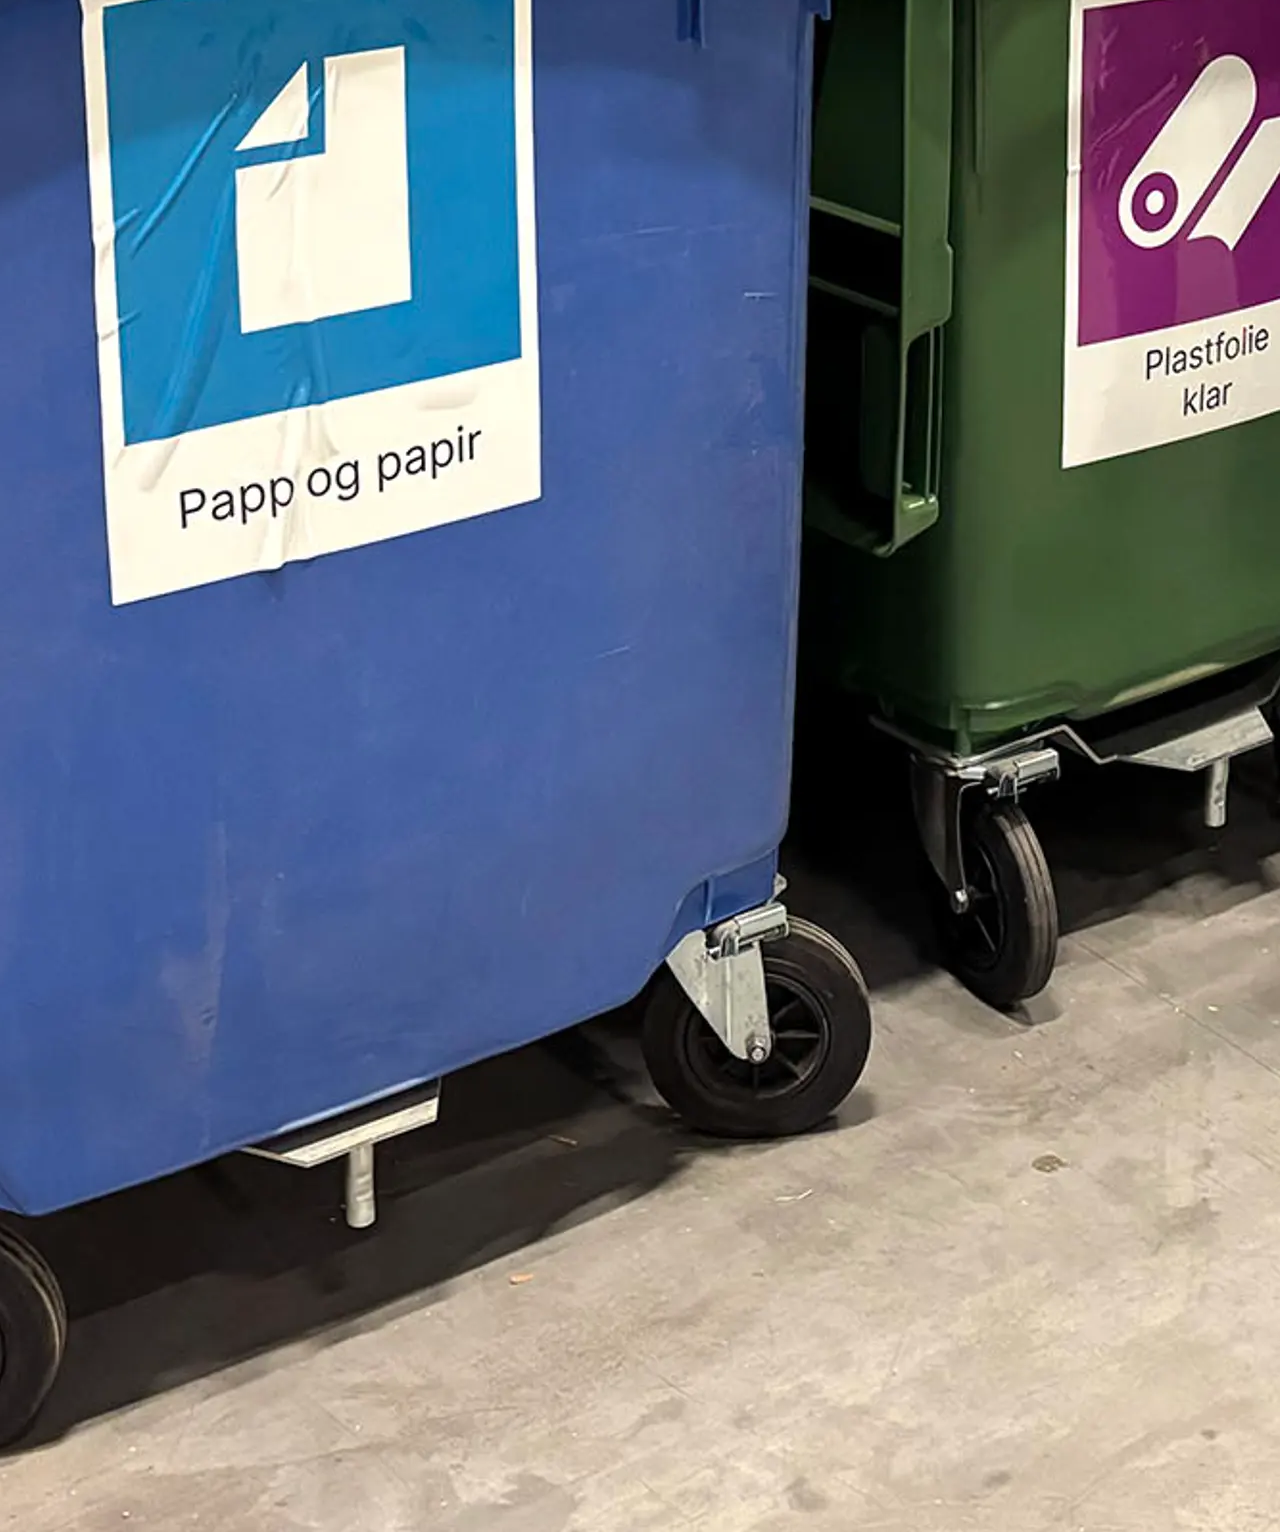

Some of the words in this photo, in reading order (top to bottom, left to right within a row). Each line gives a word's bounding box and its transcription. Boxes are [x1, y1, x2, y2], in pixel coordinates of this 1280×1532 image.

[1145, 323, 1270, 381] Plastfolie
[1183, 377, 1234, 417] klar
[179, 475, 294, 529] Papp
[306, 458, 360, 502] og
[377, 425, 483, 494] papir
